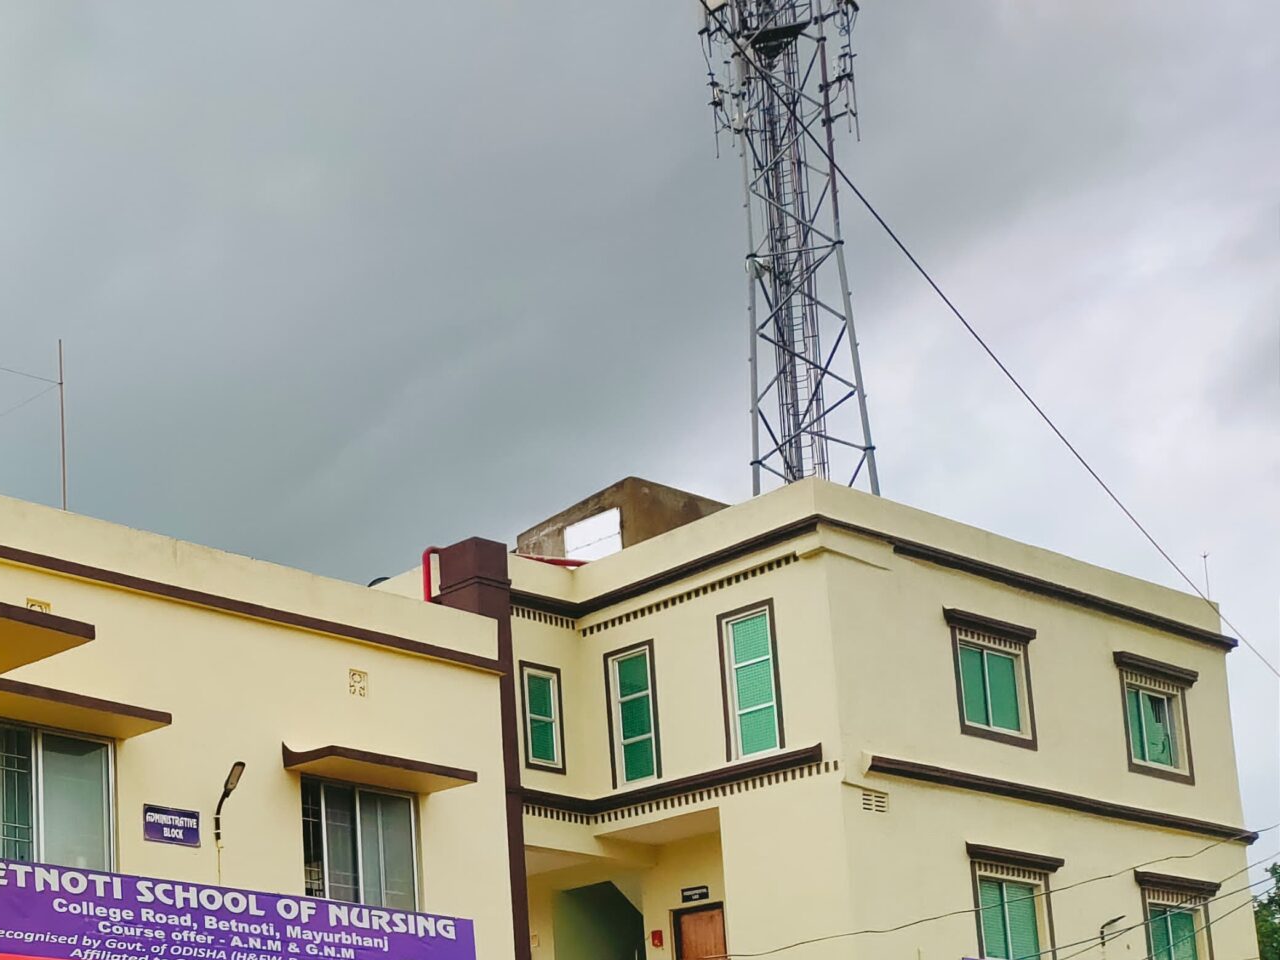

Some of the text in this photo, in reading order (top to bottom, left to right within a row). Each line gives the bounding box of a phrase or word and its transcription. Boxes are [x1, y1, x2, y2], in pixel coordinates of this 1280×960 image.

[146, 812, 198, 829] ADMINISTRATIVE
[163, 827, 184, 840] BLOCK
[52, 897, 389, 952] College Road, Betnoti, Mayurbhanj
[136, 880, 266, 917] SCHOOL
[276, 898, 317, 924] OF
[328, 903, 457, 941] NURSING
[81, 935, 101, 948] by
[105, 938, 146, 953] Govt.
[150, 944, 168, 956] of
[170, 944, 227, 960] ODISHA
[97, 920, 166, 939] Course
[171, 929, 215, 945] offer
[230, 935, 282, 952] A.N.M
[287, 942, 300, 954] &
[305, 943, 355, 960] G.N.M
